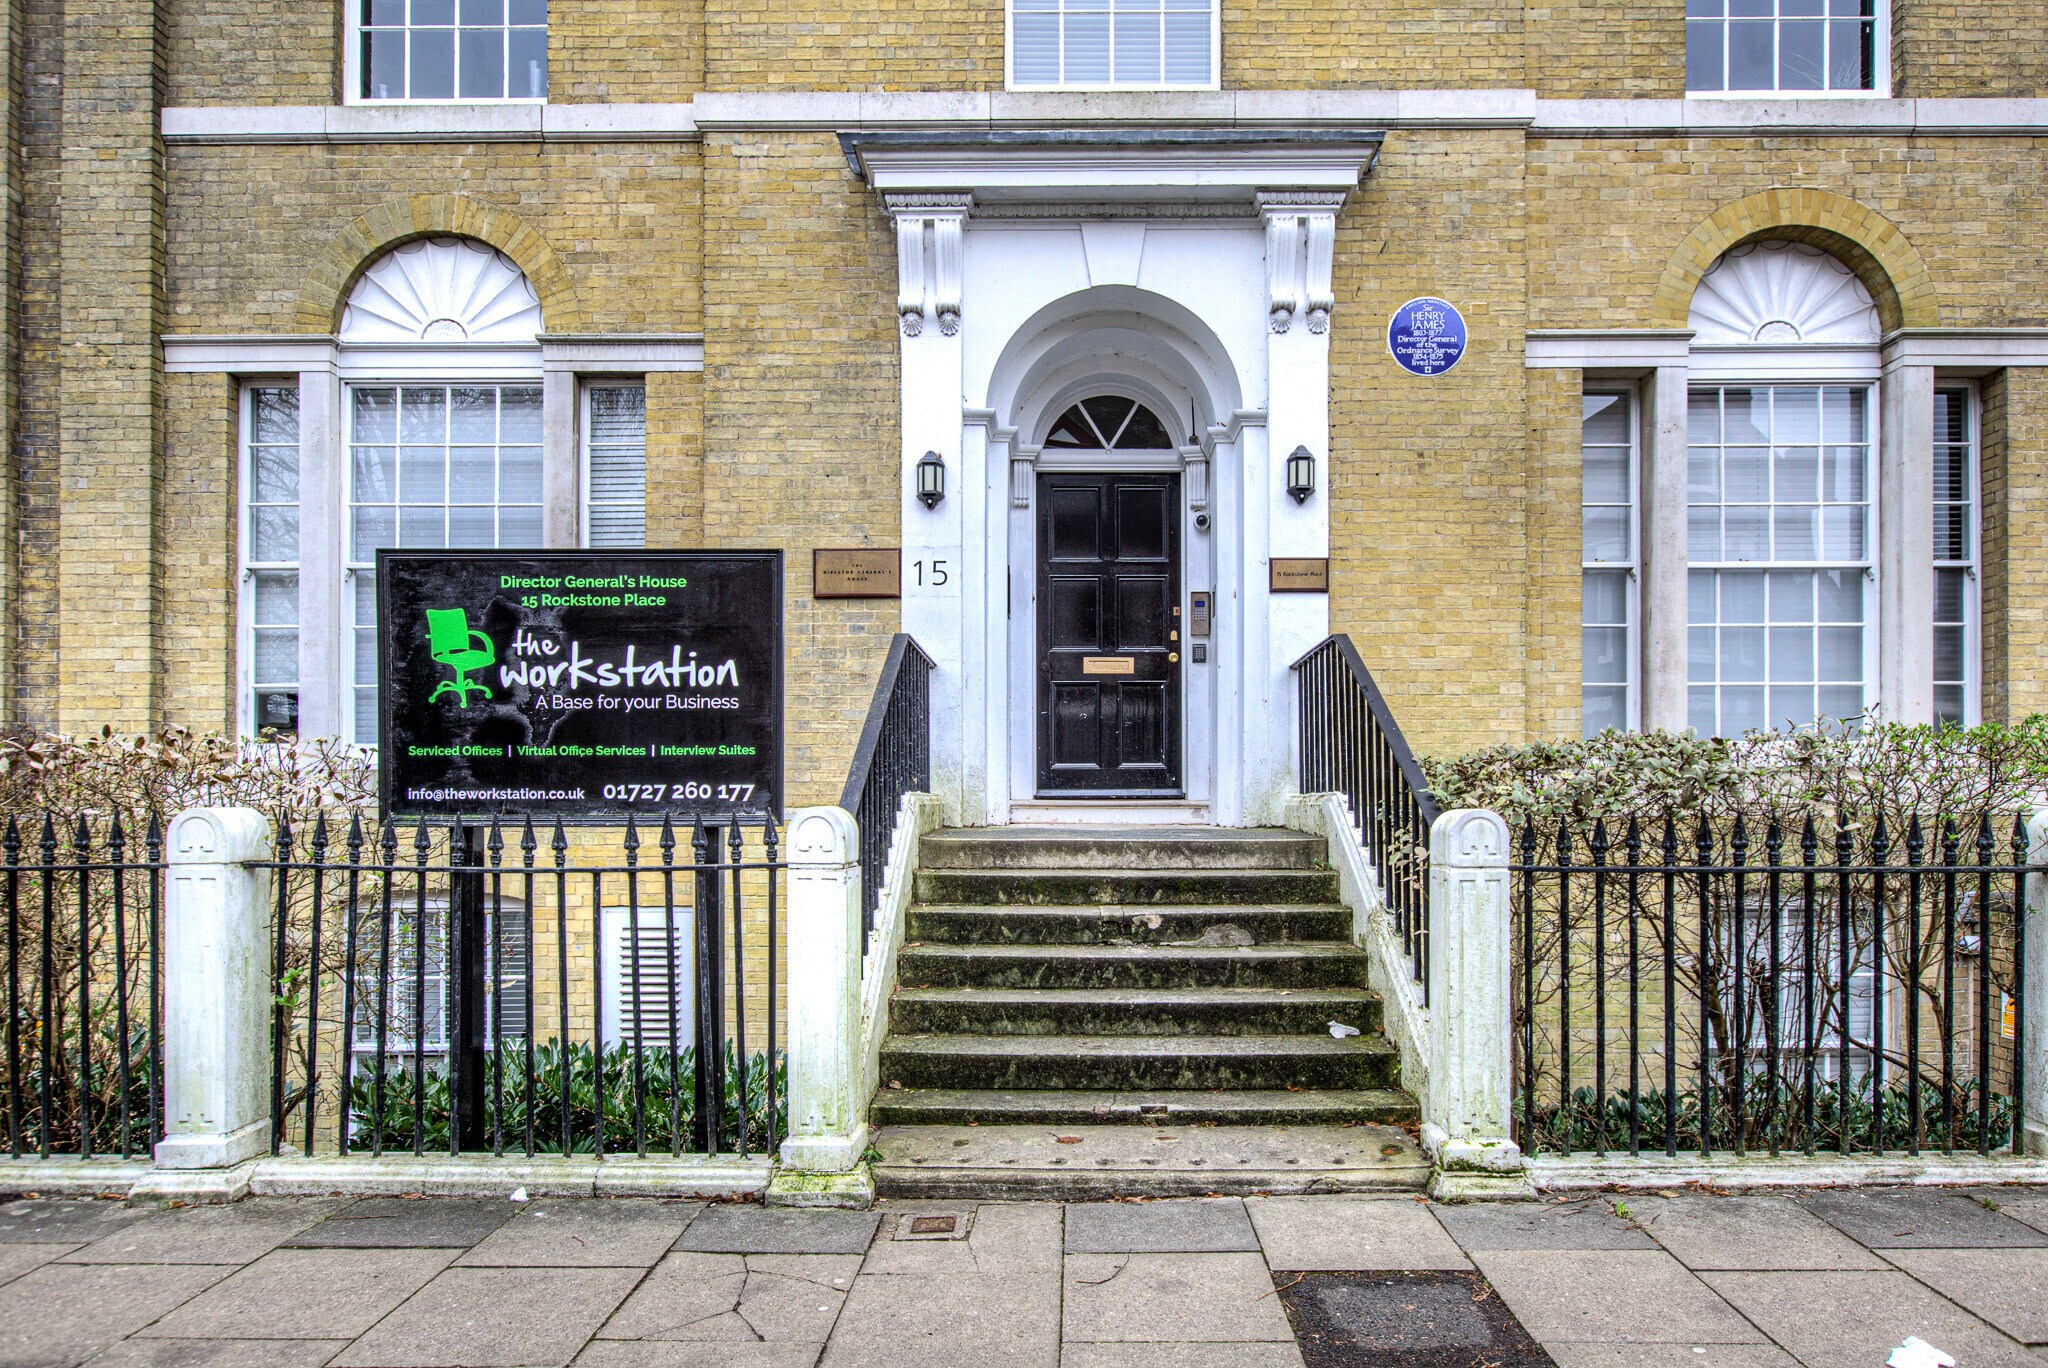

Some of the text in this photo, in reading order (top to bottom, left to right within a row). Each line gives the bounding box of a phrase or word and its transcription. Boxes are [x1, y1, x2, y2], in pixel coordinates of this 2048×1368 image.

[1423, 303, 1434, 311] Sir
[1411, 311, 1445, 320] HENRY
[1411, 320, 1445, 330] JAMES
[1434, 347, 1459, 355] Survey
[913, 560, 948, 586] 15
[500, 575, 687, 589] Director General's House
[521, 594, 666, 608] 15 Rockstone Place
[512, 628, 560, 656] the
[499, 641, 740, 690] workstation
[535, 694, 740, 713] A Base for your Business
[408, 745, 756, 757] Serviced Offices Virtual Office Services Interview Suites
[407, 783, 755, 802] info@theworkstation.co.uk 01727 260 177
